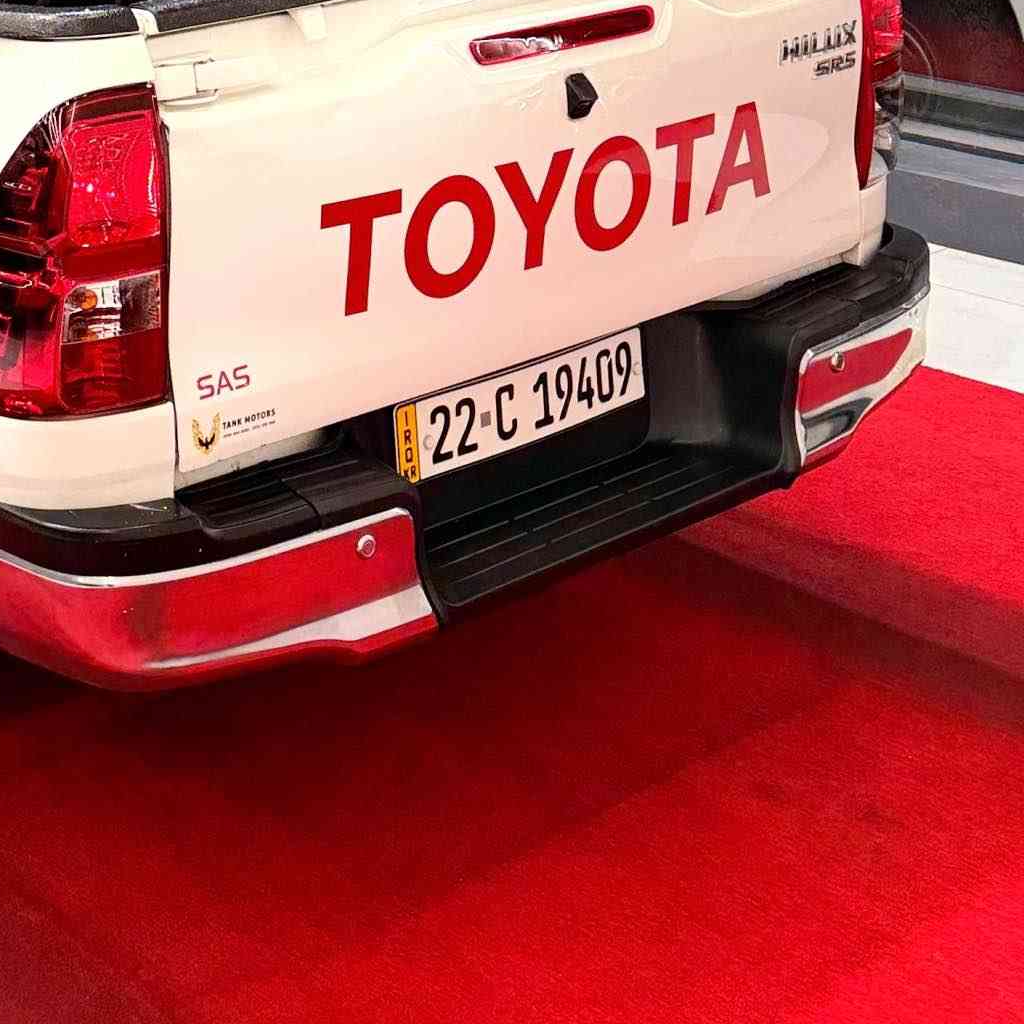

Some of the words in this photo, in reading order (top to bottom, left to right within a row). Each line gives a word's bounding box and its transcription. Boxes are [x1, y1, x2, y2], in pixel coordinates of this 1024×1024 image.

[777, 19, 857, 66] HILUX
[320, 101, 771, 316] TOYOTA
[196, 364, 250, 400] SAS
[429, 397, 479, 465] 22
[495, 383, 518, 441] C
[532, 341, 632, 430] 19409
[222, 418, 242, 430] TANK
[244, 408, 276, 423] MOTORS
